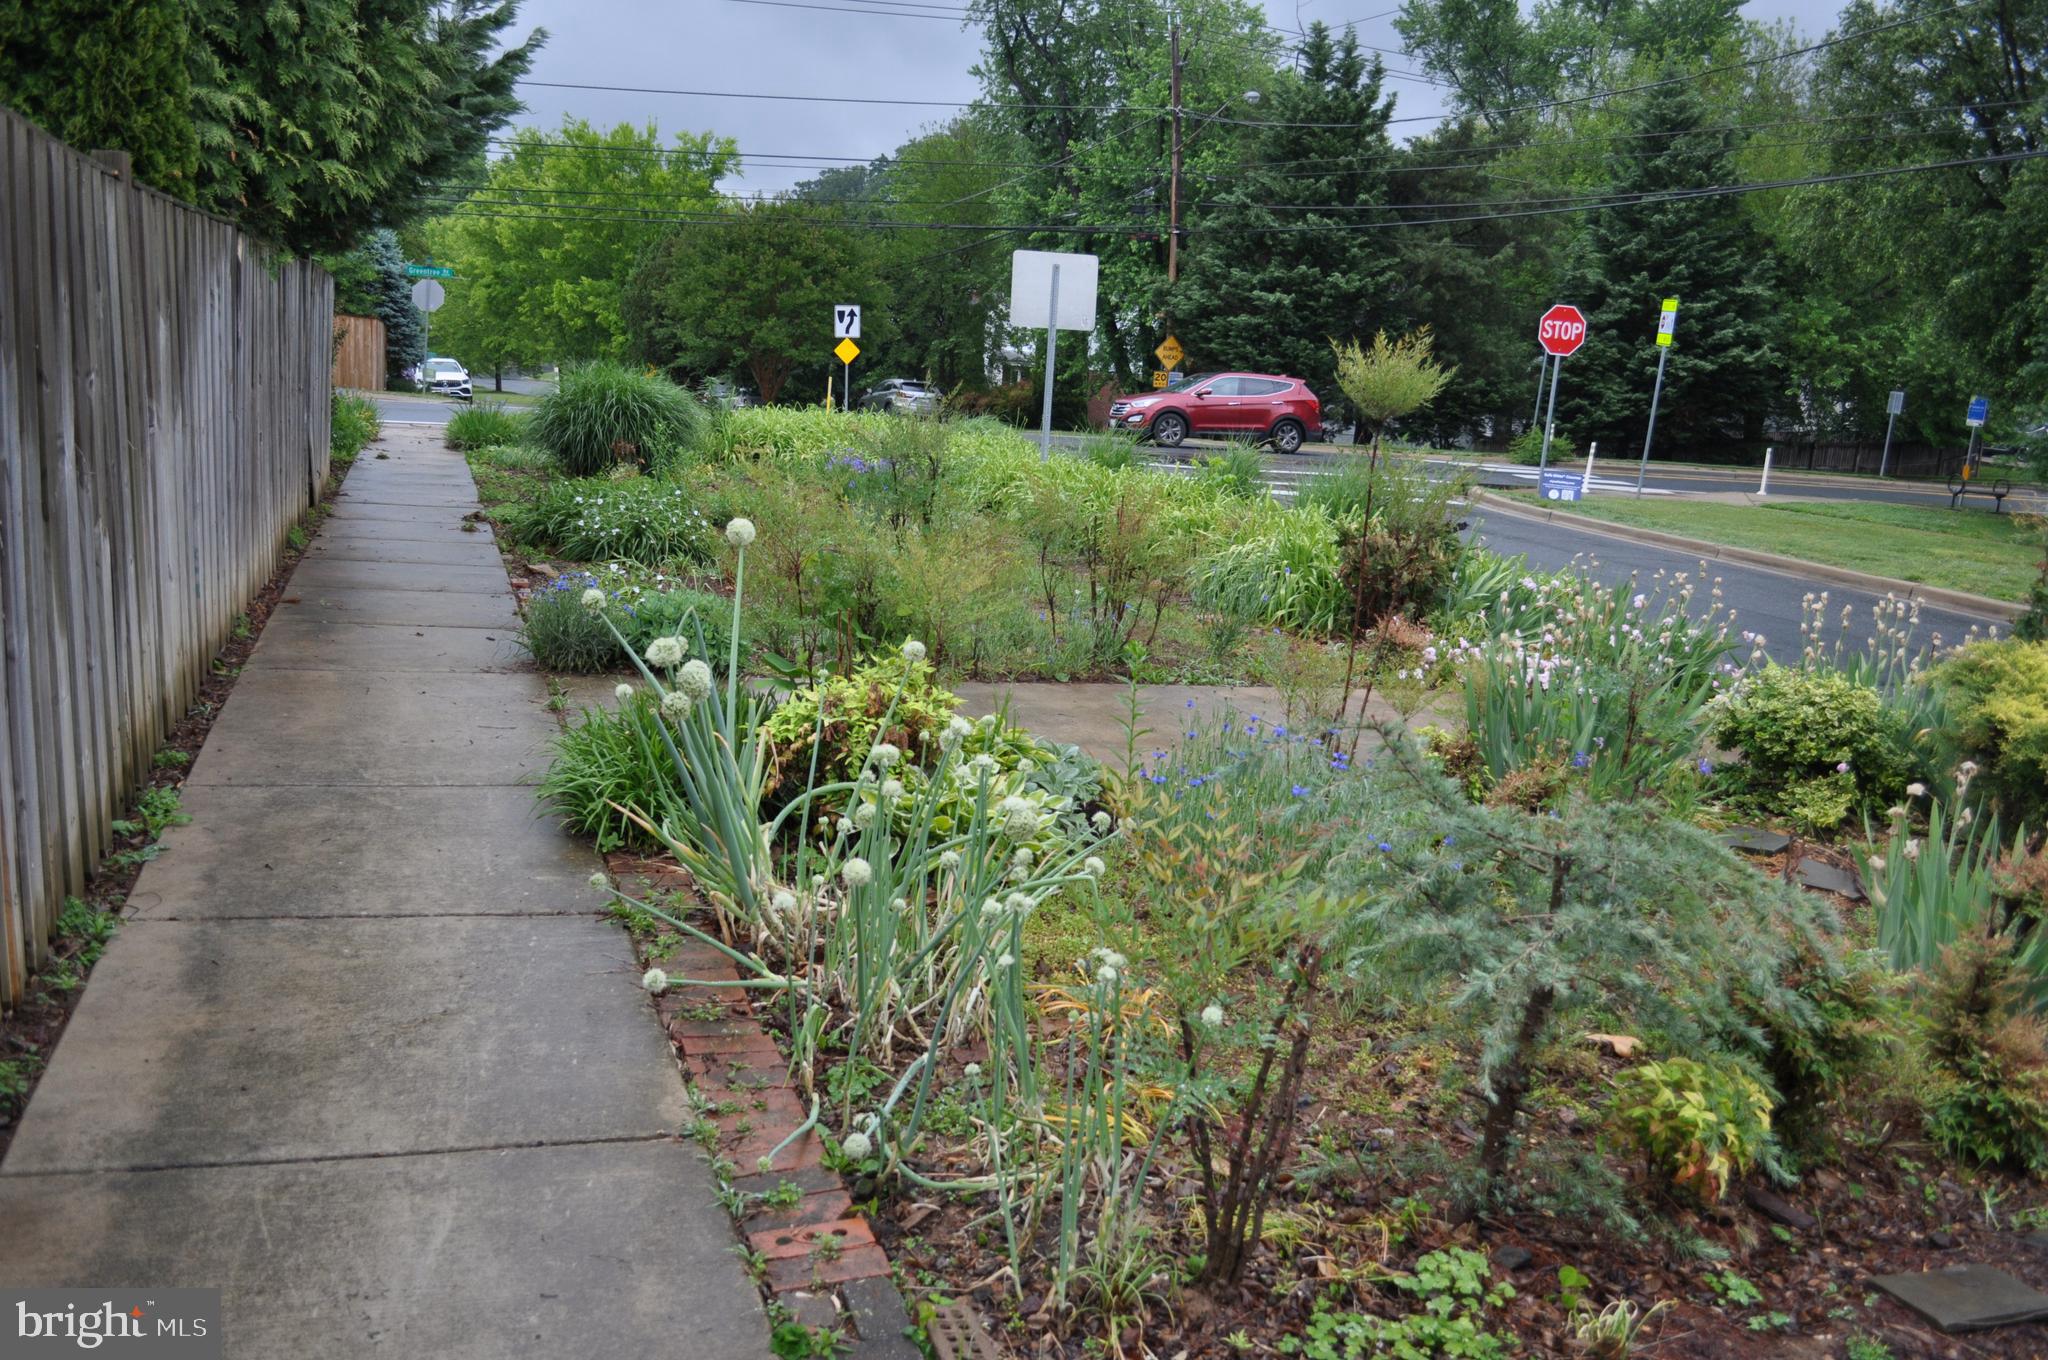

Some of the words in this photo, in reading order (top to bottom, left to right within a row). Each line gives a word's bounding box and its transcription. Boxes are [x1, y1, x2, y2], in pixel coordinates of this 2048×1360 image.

[408, 266, 440, 276] Greentree
[1542, 320, 1582, 340] STOP
[1155, 373, 1167, 381] 20
